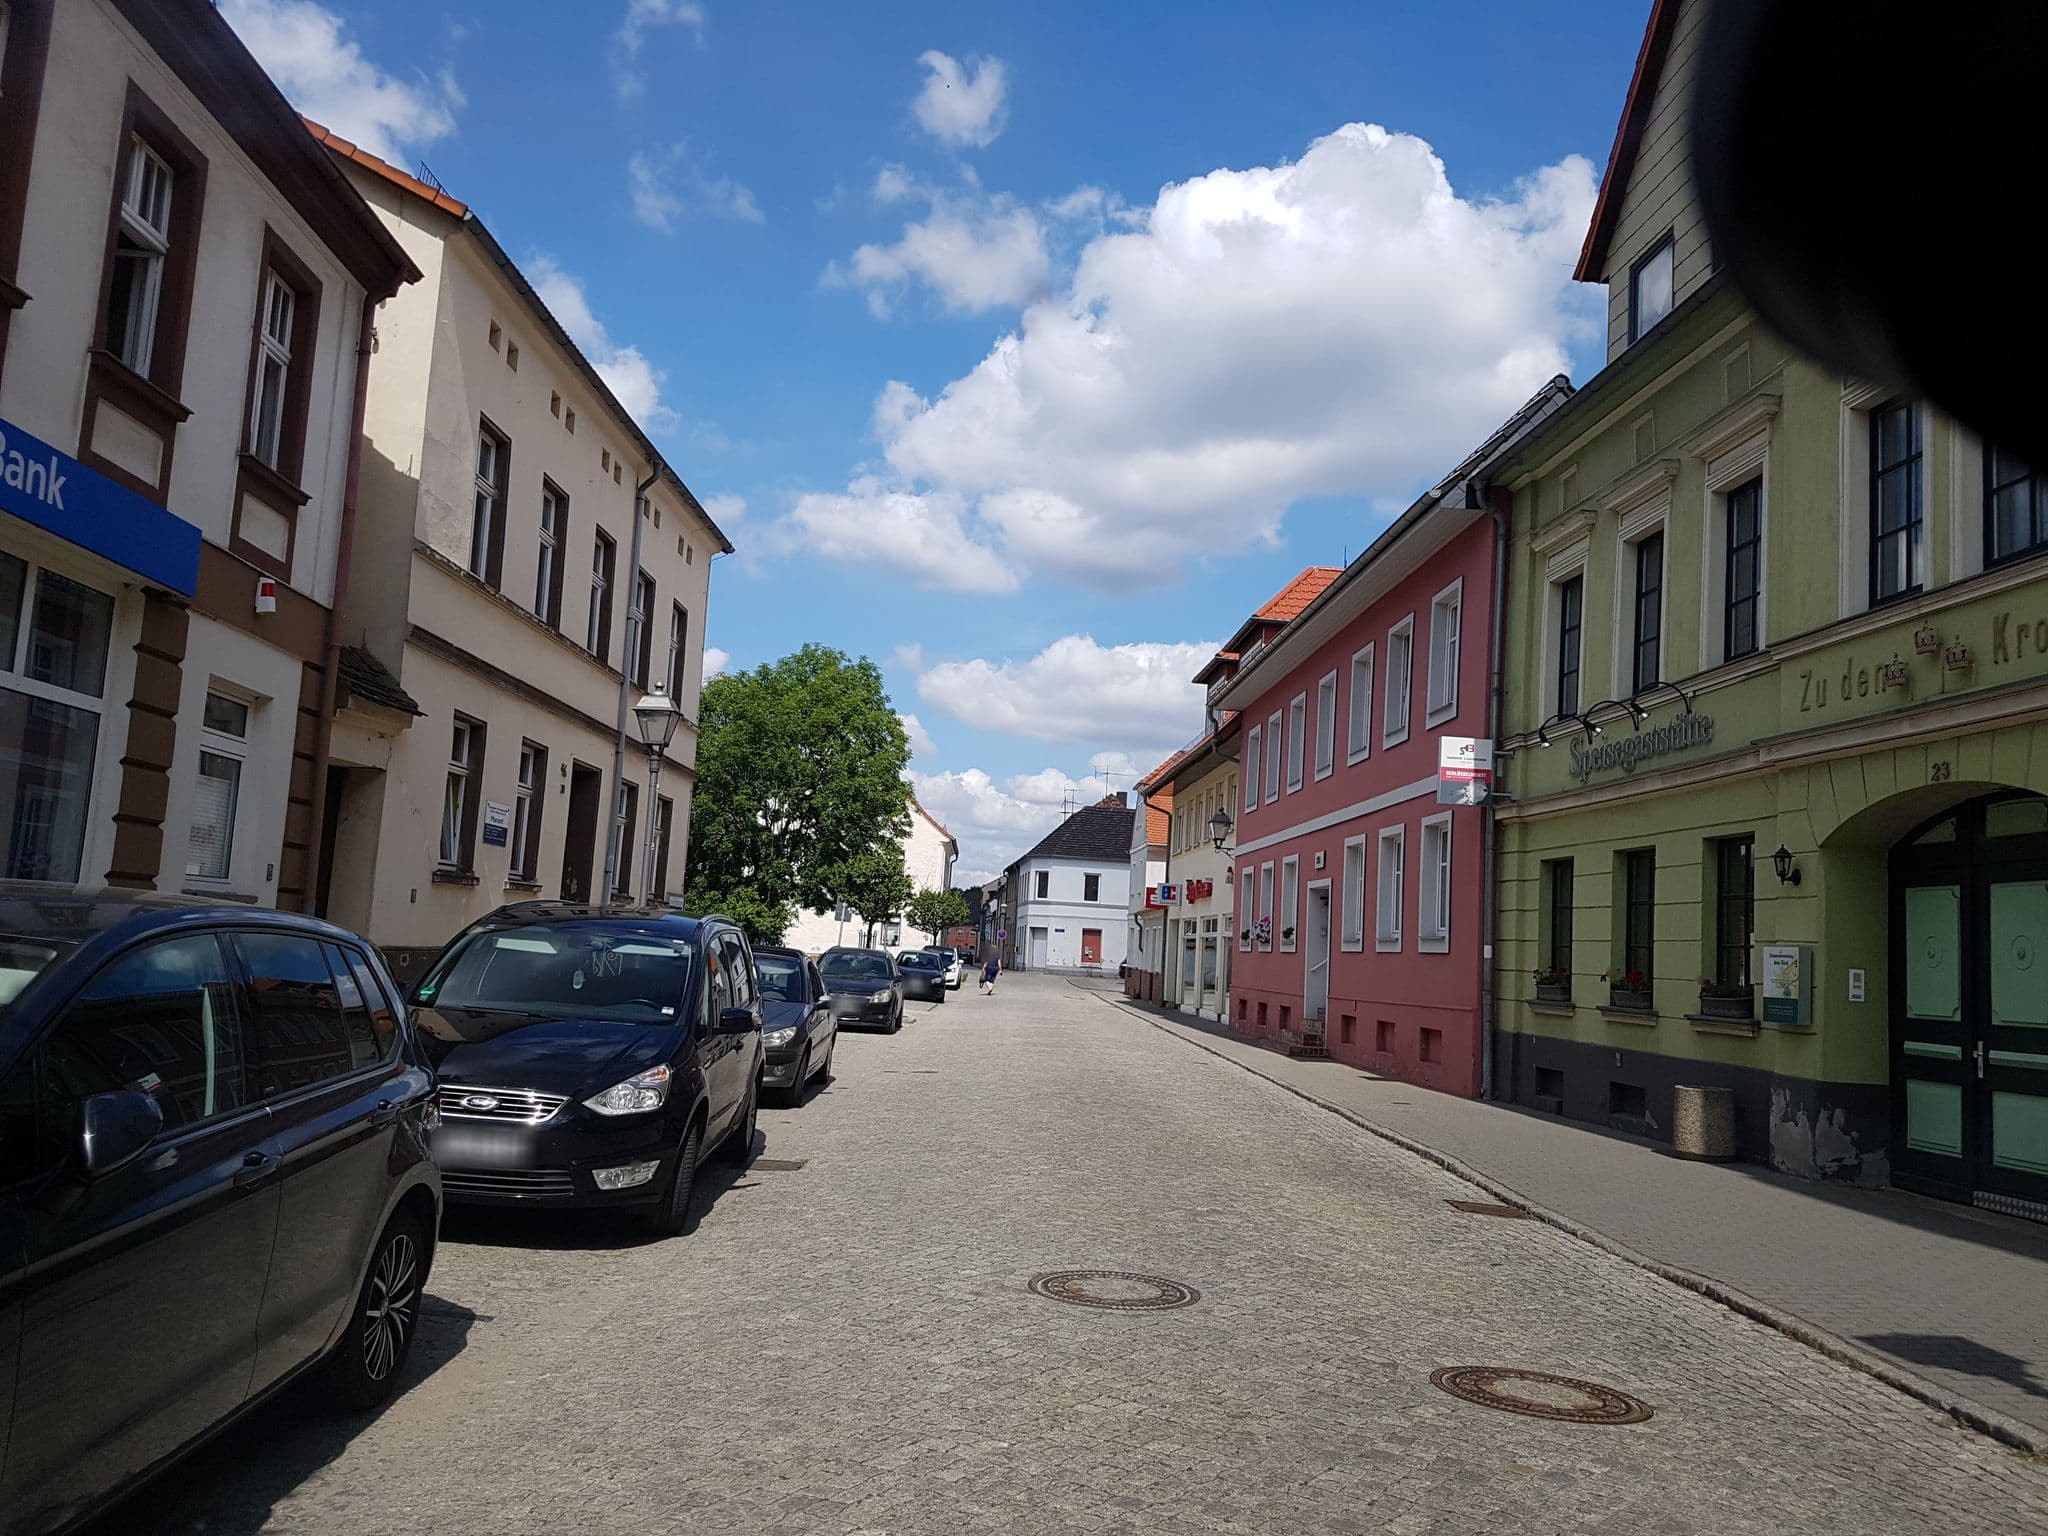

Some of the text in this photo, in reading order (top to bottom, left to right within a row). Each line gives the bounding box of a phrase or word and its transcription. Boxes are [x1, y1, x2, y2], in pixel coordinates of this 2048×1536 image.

[1800, 669, 1828, 712] Zu
[1569, 712, 1713, 784] Speisegaststätte
[1931, 761, 1950, 782] 23
